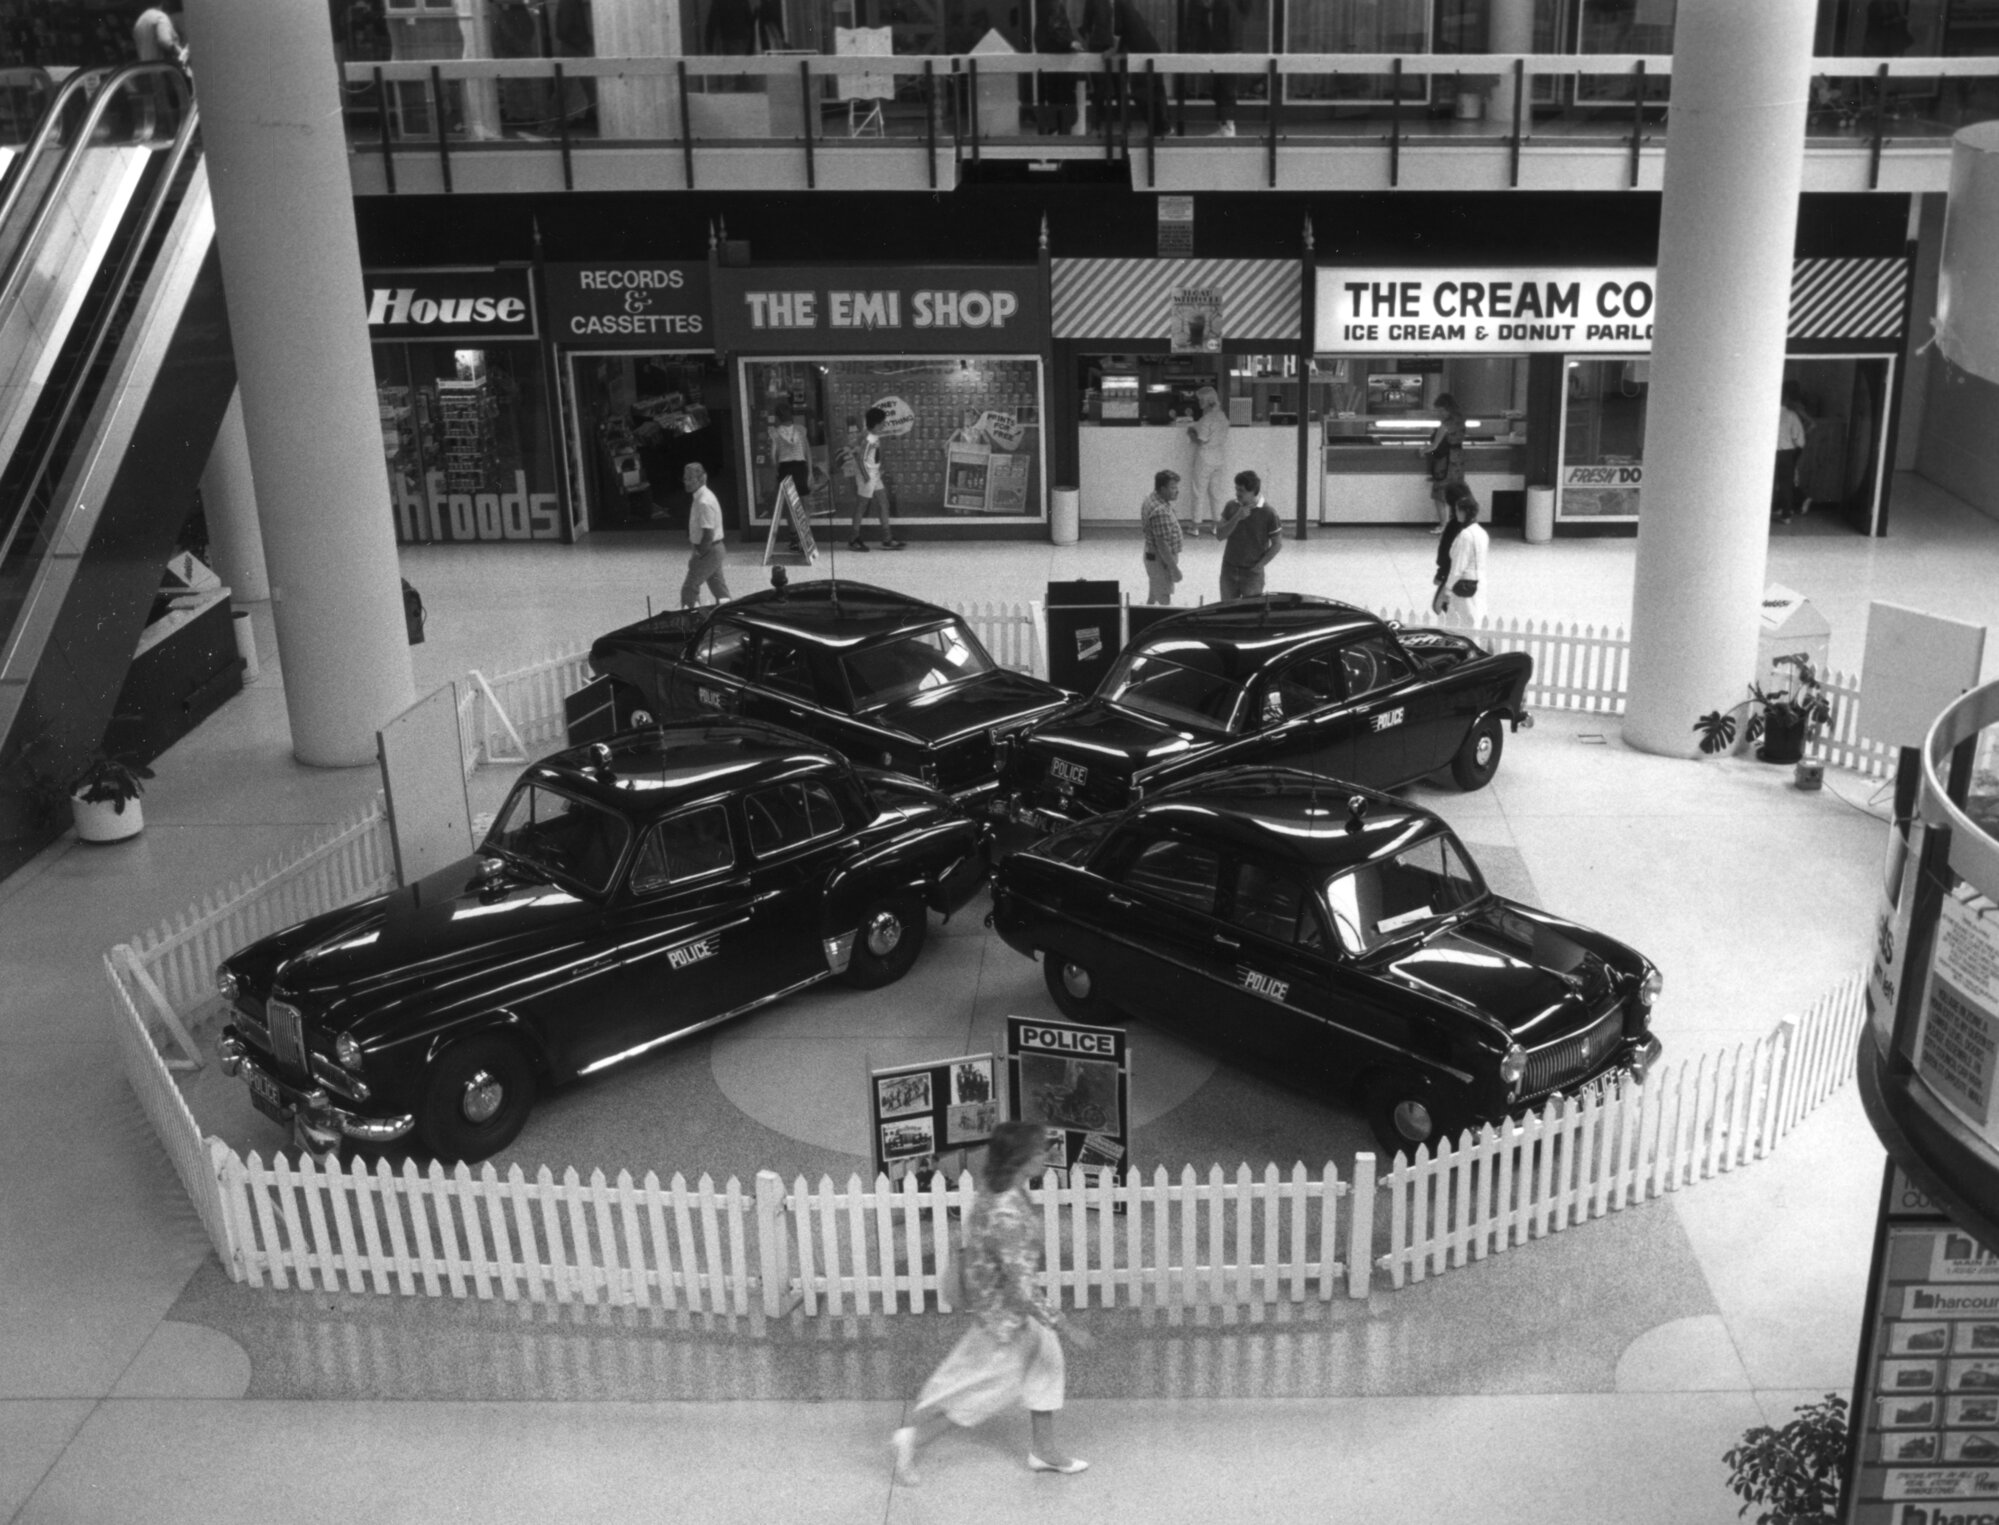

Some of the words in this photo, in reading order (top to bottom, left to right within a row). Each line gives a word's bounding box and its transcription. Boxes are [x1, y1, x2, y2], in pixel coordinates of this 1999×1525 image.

[580, 270, 684, 288] RECORDS
[367, 289, 526, 324] House
[624, 290, 653, 313] &
[745, 290, 817, 328] THE
[828, 290, 900, 329] EMI
[911, 288, 1018, 328] SHOP
[1345, 281, 1422, 317] THE
[1433, 281, 1580, 318] CREAM
[570, 315, 703, 334] CASSETTES
[1344, 324, 1379, 341] ICE
[1389, 324, 1466, 341] CREAM
[1475, 325, 1489, 341] &
[1498, 324, 1575, 341] DONUT
[1567, 468, 1618, 484] FRESH
[1052, 760, 1085, 783] POLICE
[667, 940, 712, 969] POLICE
[1245, 971, 1289, 1000] POLICE
[1022, 1027, 1112, 1054] POLICE
